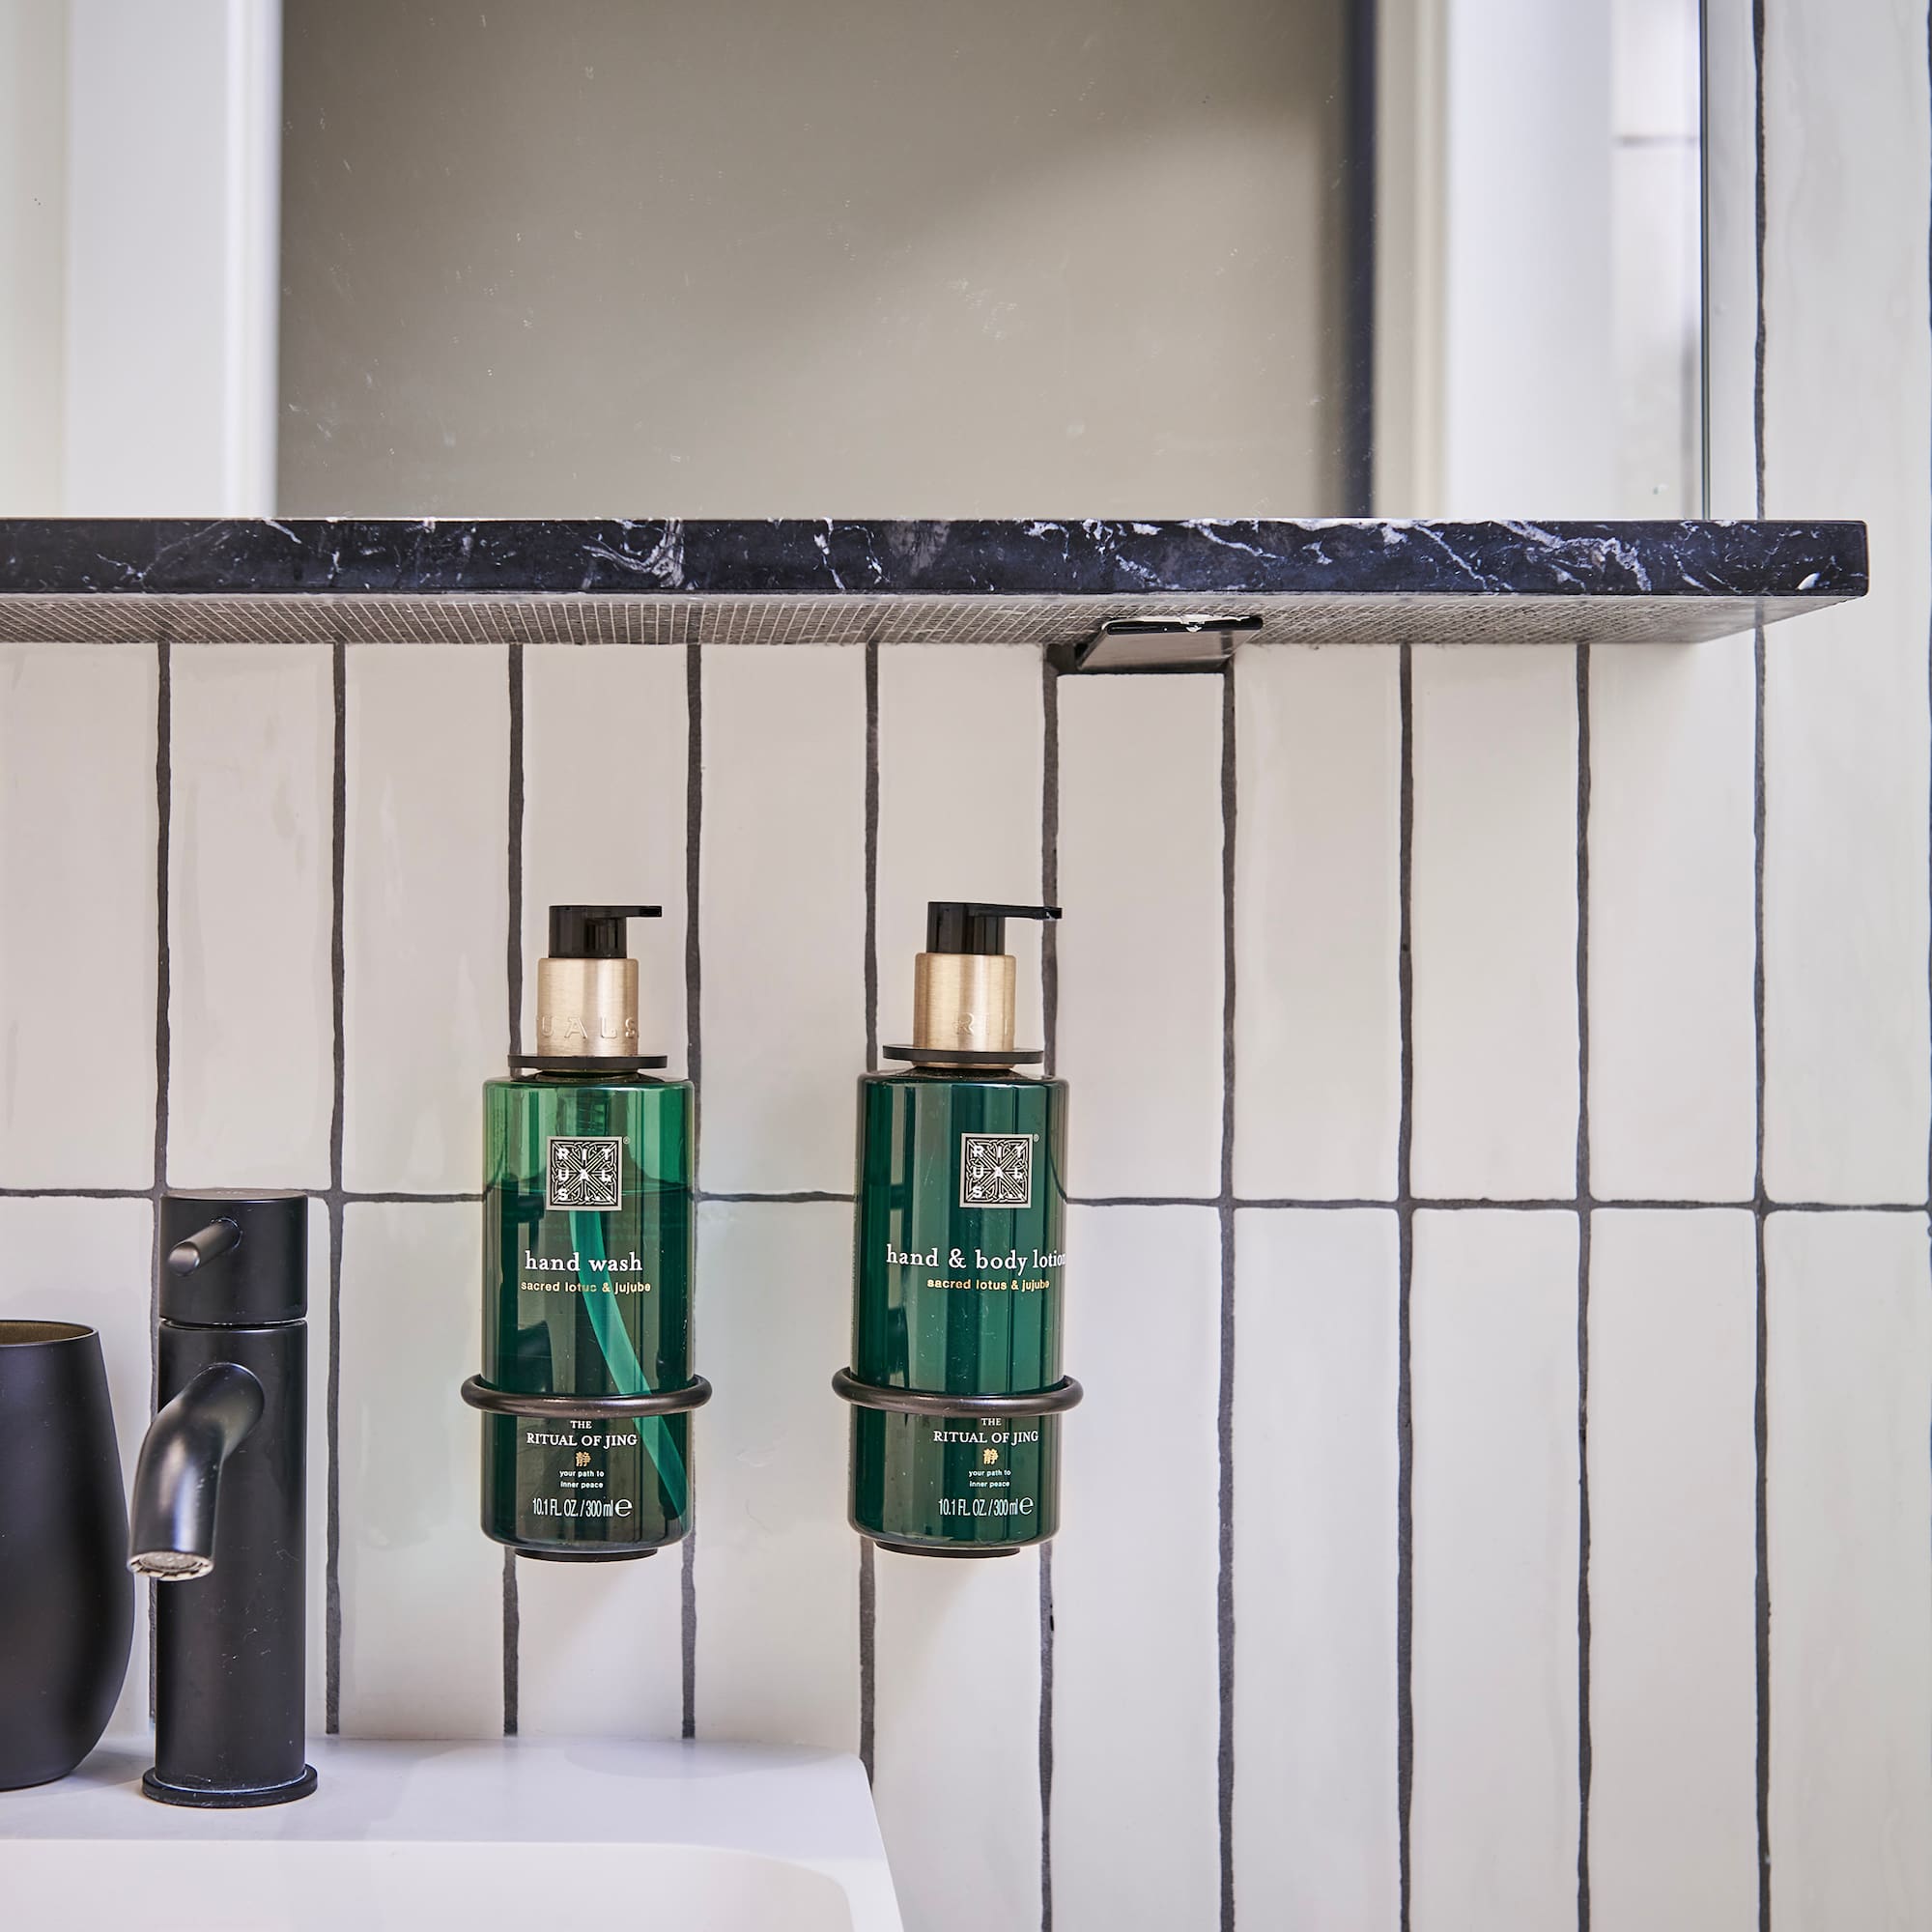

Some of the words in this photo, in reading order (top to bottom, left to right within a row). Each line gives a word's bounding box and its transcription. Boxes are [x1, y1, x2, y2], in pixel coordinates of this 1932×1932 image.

[525, 1250, 581, 1271] hand
[588, 1251, 643, 1271] wash
[886, 1243, 939, 1267] hand
[948, 1247, 966, 1269] &
[975, 1249, 1028, 1276] body
[521, 1281, 559, 1292] sacred
[602, 1282, 611, 1293] &
[614, 1282, 651, 1294] jujube
[926, 1278, 972, 1290] sacred
[976, 1279, 1008, 1291] lotus
[1010, 1280, 1019, 1291] &
[1021, 1279, 1050, 1293] jujube
[570, 1420, 593, 1430] THE
[981, 1417, 1003, 1427] THE
[526, 1432, 578, 1446] RITUAL
[582, 1435, 602, 1446] OF
[603, 1434, 638, 1449] JING
[933, 1430, 987, 1443] RITUAL
[991, 1432, 1009, 1443] OF
[1010, 1430, 1038, 1446] JING
[559, 1469, 576, 1479] your
[578, 1469, 595, 1479] path
[596, 1469, 605, 1478] to
[968, 1469, 985, 1478] your
[986, 1469, 1003, 1479] path
[989, 1480, 1010, 1489] peace
[532, 1497, 549, 1516] 10.1
[939, 1498, 955, 1516] 10.1
